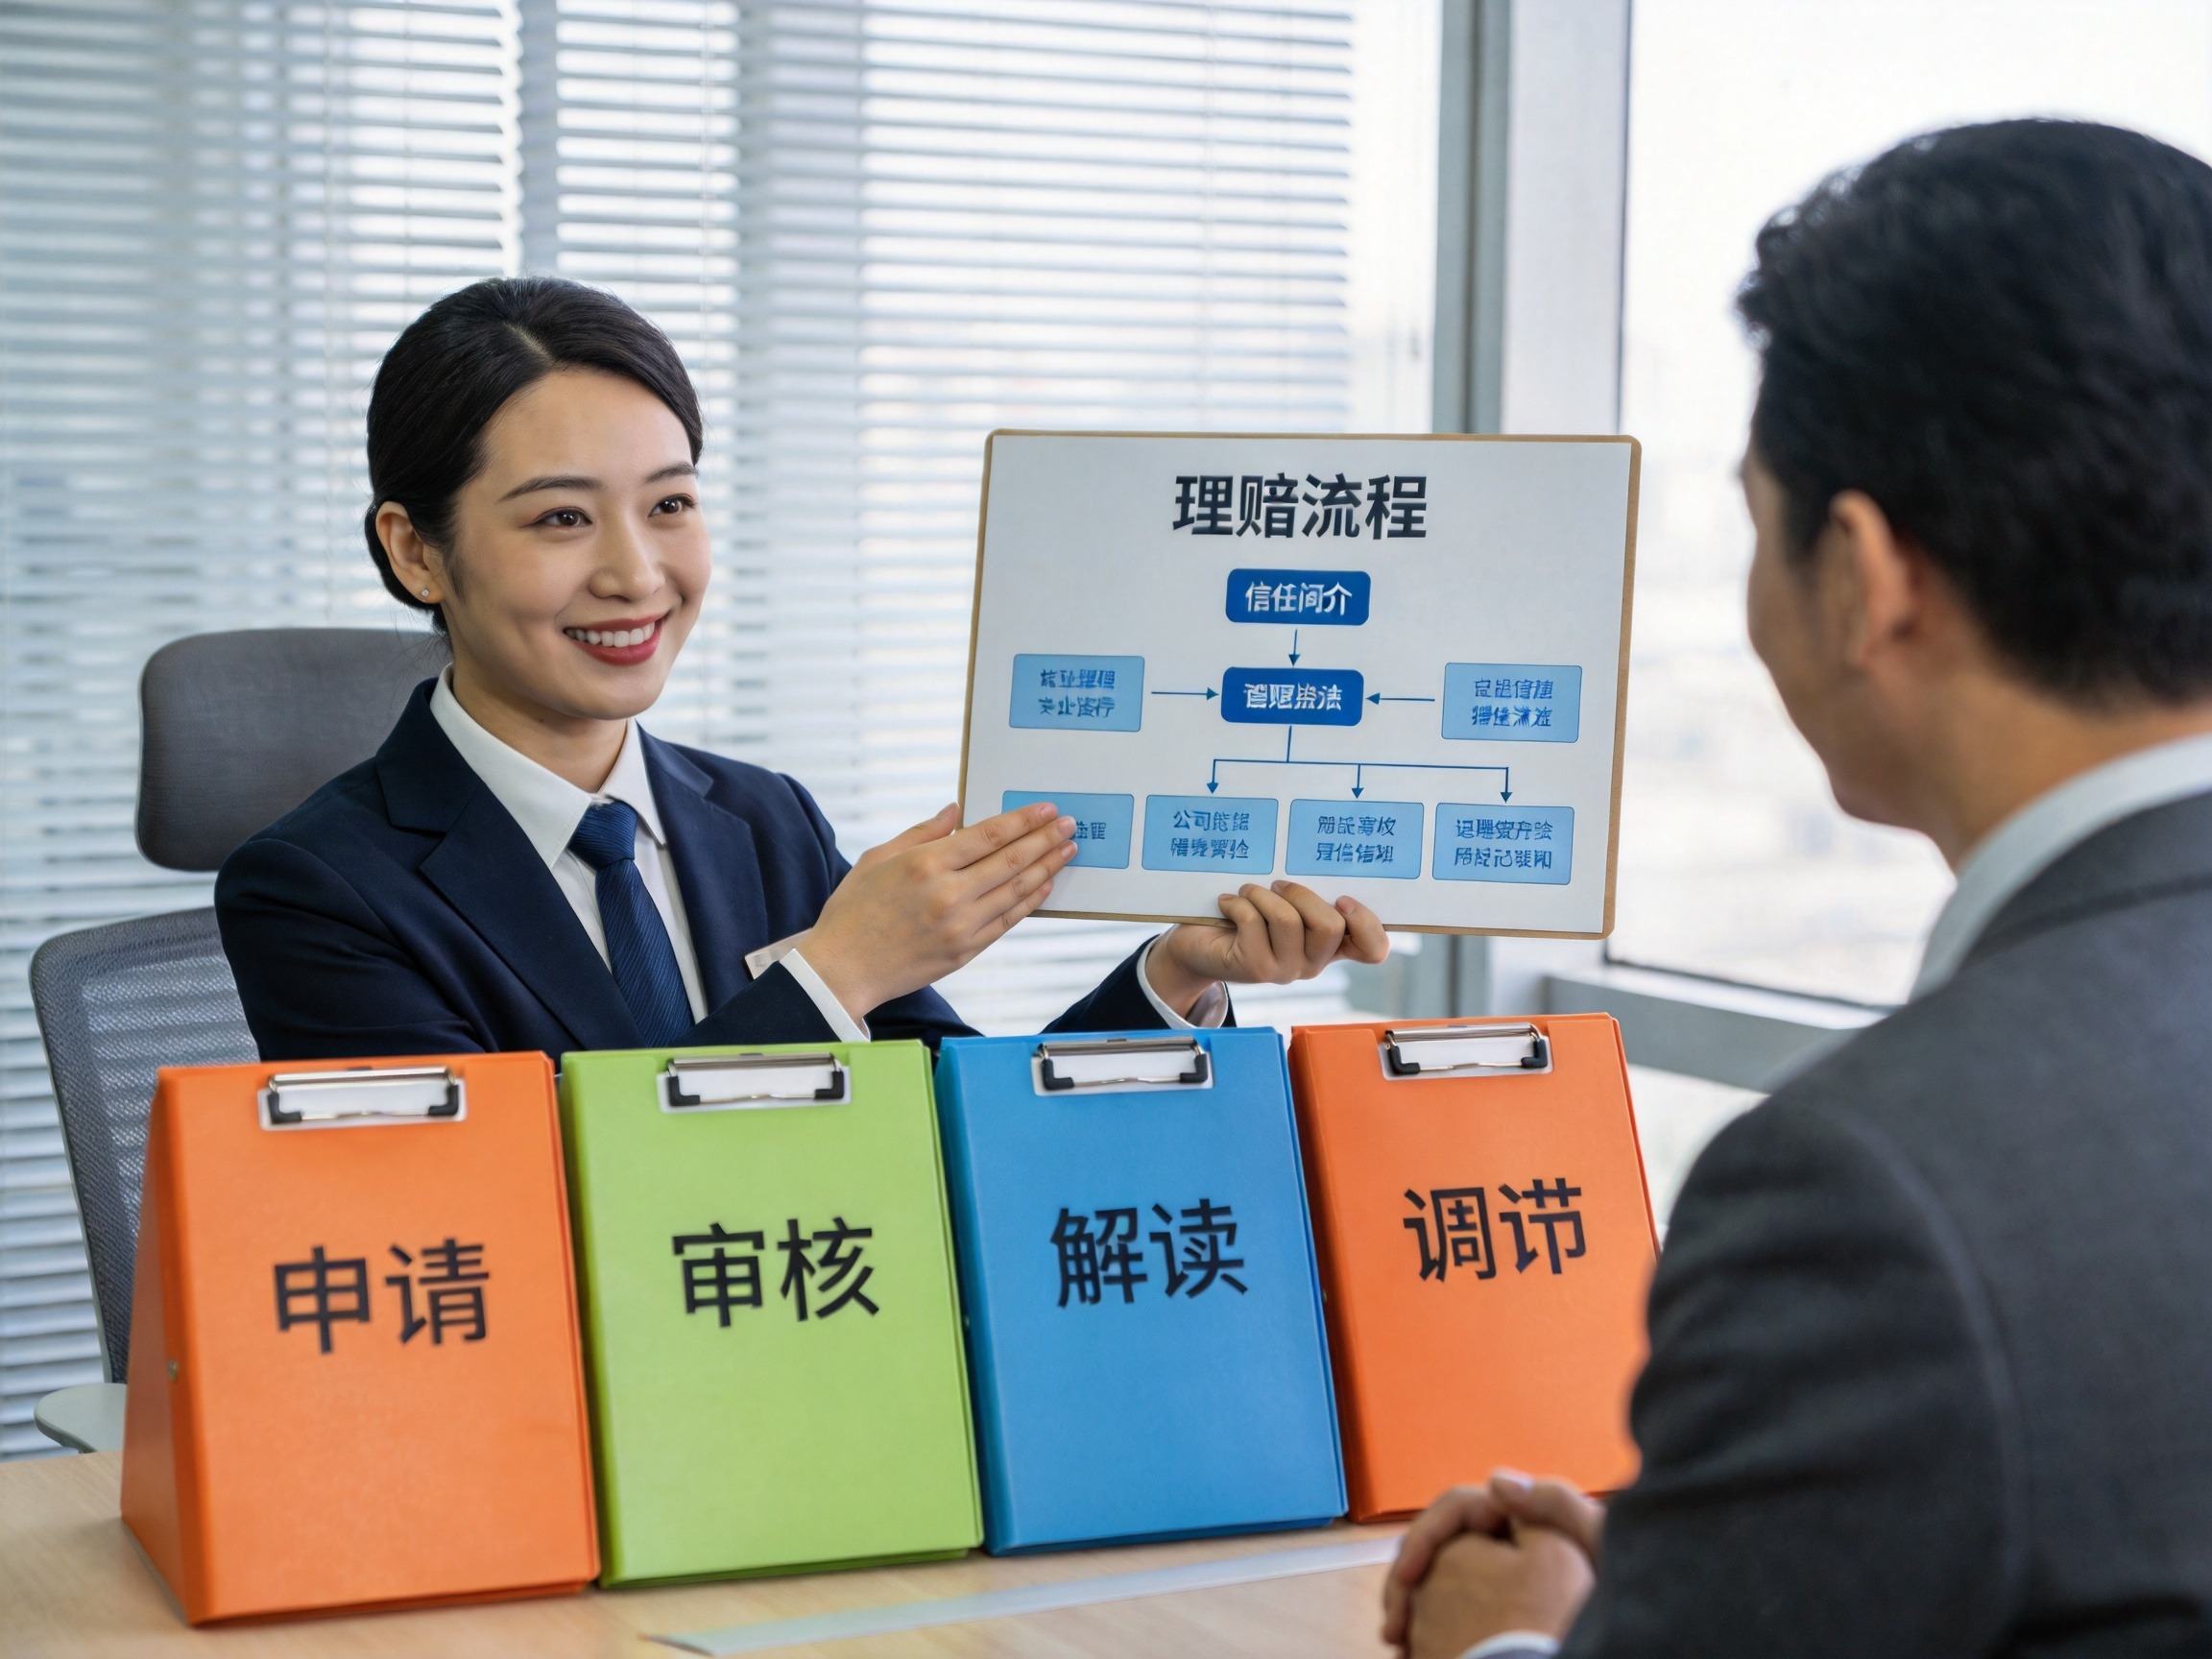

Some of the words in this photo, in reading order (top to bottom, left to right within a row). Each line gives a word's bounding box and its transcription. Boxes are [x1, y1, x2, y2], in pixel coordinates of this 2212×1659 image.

[1172, 472, 1428, 541] 理赔流程
[273, 1238, 491, 1355] 申请
[672, 1216, 880, 1329] 审核
[1050, 1198, 1249, 1309] 解读
